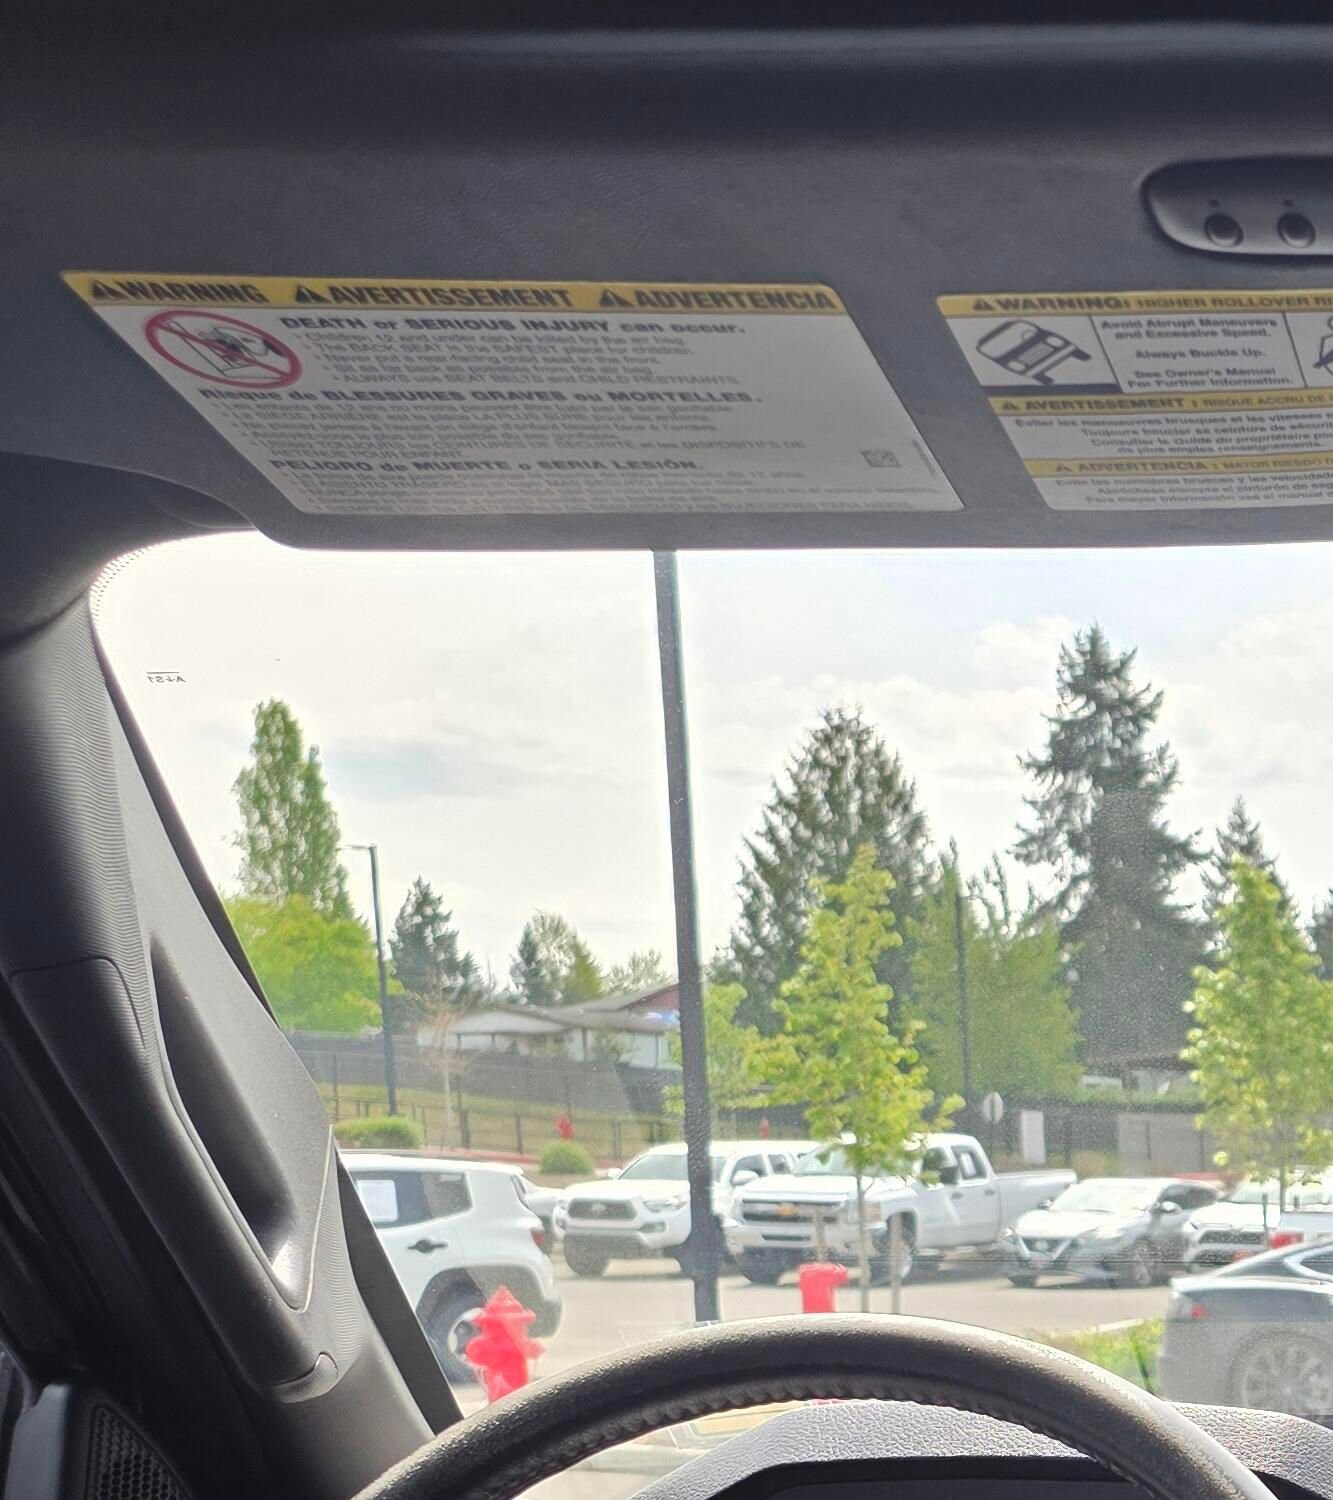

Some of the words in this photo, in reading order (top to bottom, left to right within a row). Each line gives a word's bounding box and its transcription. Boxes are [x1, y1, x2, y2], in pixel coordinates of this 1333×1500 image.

[114, 280, 271, 303] WARNING
[328, 285, 575, 307] AVERTISSEMENT
[634, 289, 838, 310] ADVERTENCIA
[1136, 298, 1208, 309] HIGHER
[1210, 296, 1304, 308] ROLLOVER
[281, 317, 369, 329] DEATH
[373, 320, 399, 330] or
[405, 319, 517, 330] SERIOUS
[520, 320, 609, 331] INJURY
[619, 323, 664, 332] can
[670, 323, 746, 333] occur.
[1101, 319, 1142, 330] Avoid
[1147, 319, 1197, 332] Abrupt
[1200, 317, 1278, 328] Maneuvers
[1114, 329, 1143, 339] and
[1147, 328, 1220, 339] Excessive
[1222, 327, 1272, 340] Speed.
[1136, 348, 1187, 361] Always
[1190, 347, 1239, 359] Buckle
[1134, 369, 1162, 379] See
[1224, 366, 1277, 377] Manual
[1127, 379, 1155, 390] For
[1157, 378, 1207, 389] Further
[288, 390, 319, 401] de
[320, 390, 467, 401] BLESSURES
[470, 391, 568, 401] GRAVES
[573, 392, 603, 402] ou
[606, 391, 763, 403] MORTELLES.
[1025, 398, 1185, 410] AVERTISSEMENT
[270, 460, 374, 471] PELIGRO
[411, 460, 513, 471] MUERTE
[1078, 461, 1209, 472] ADVERTENCIA
